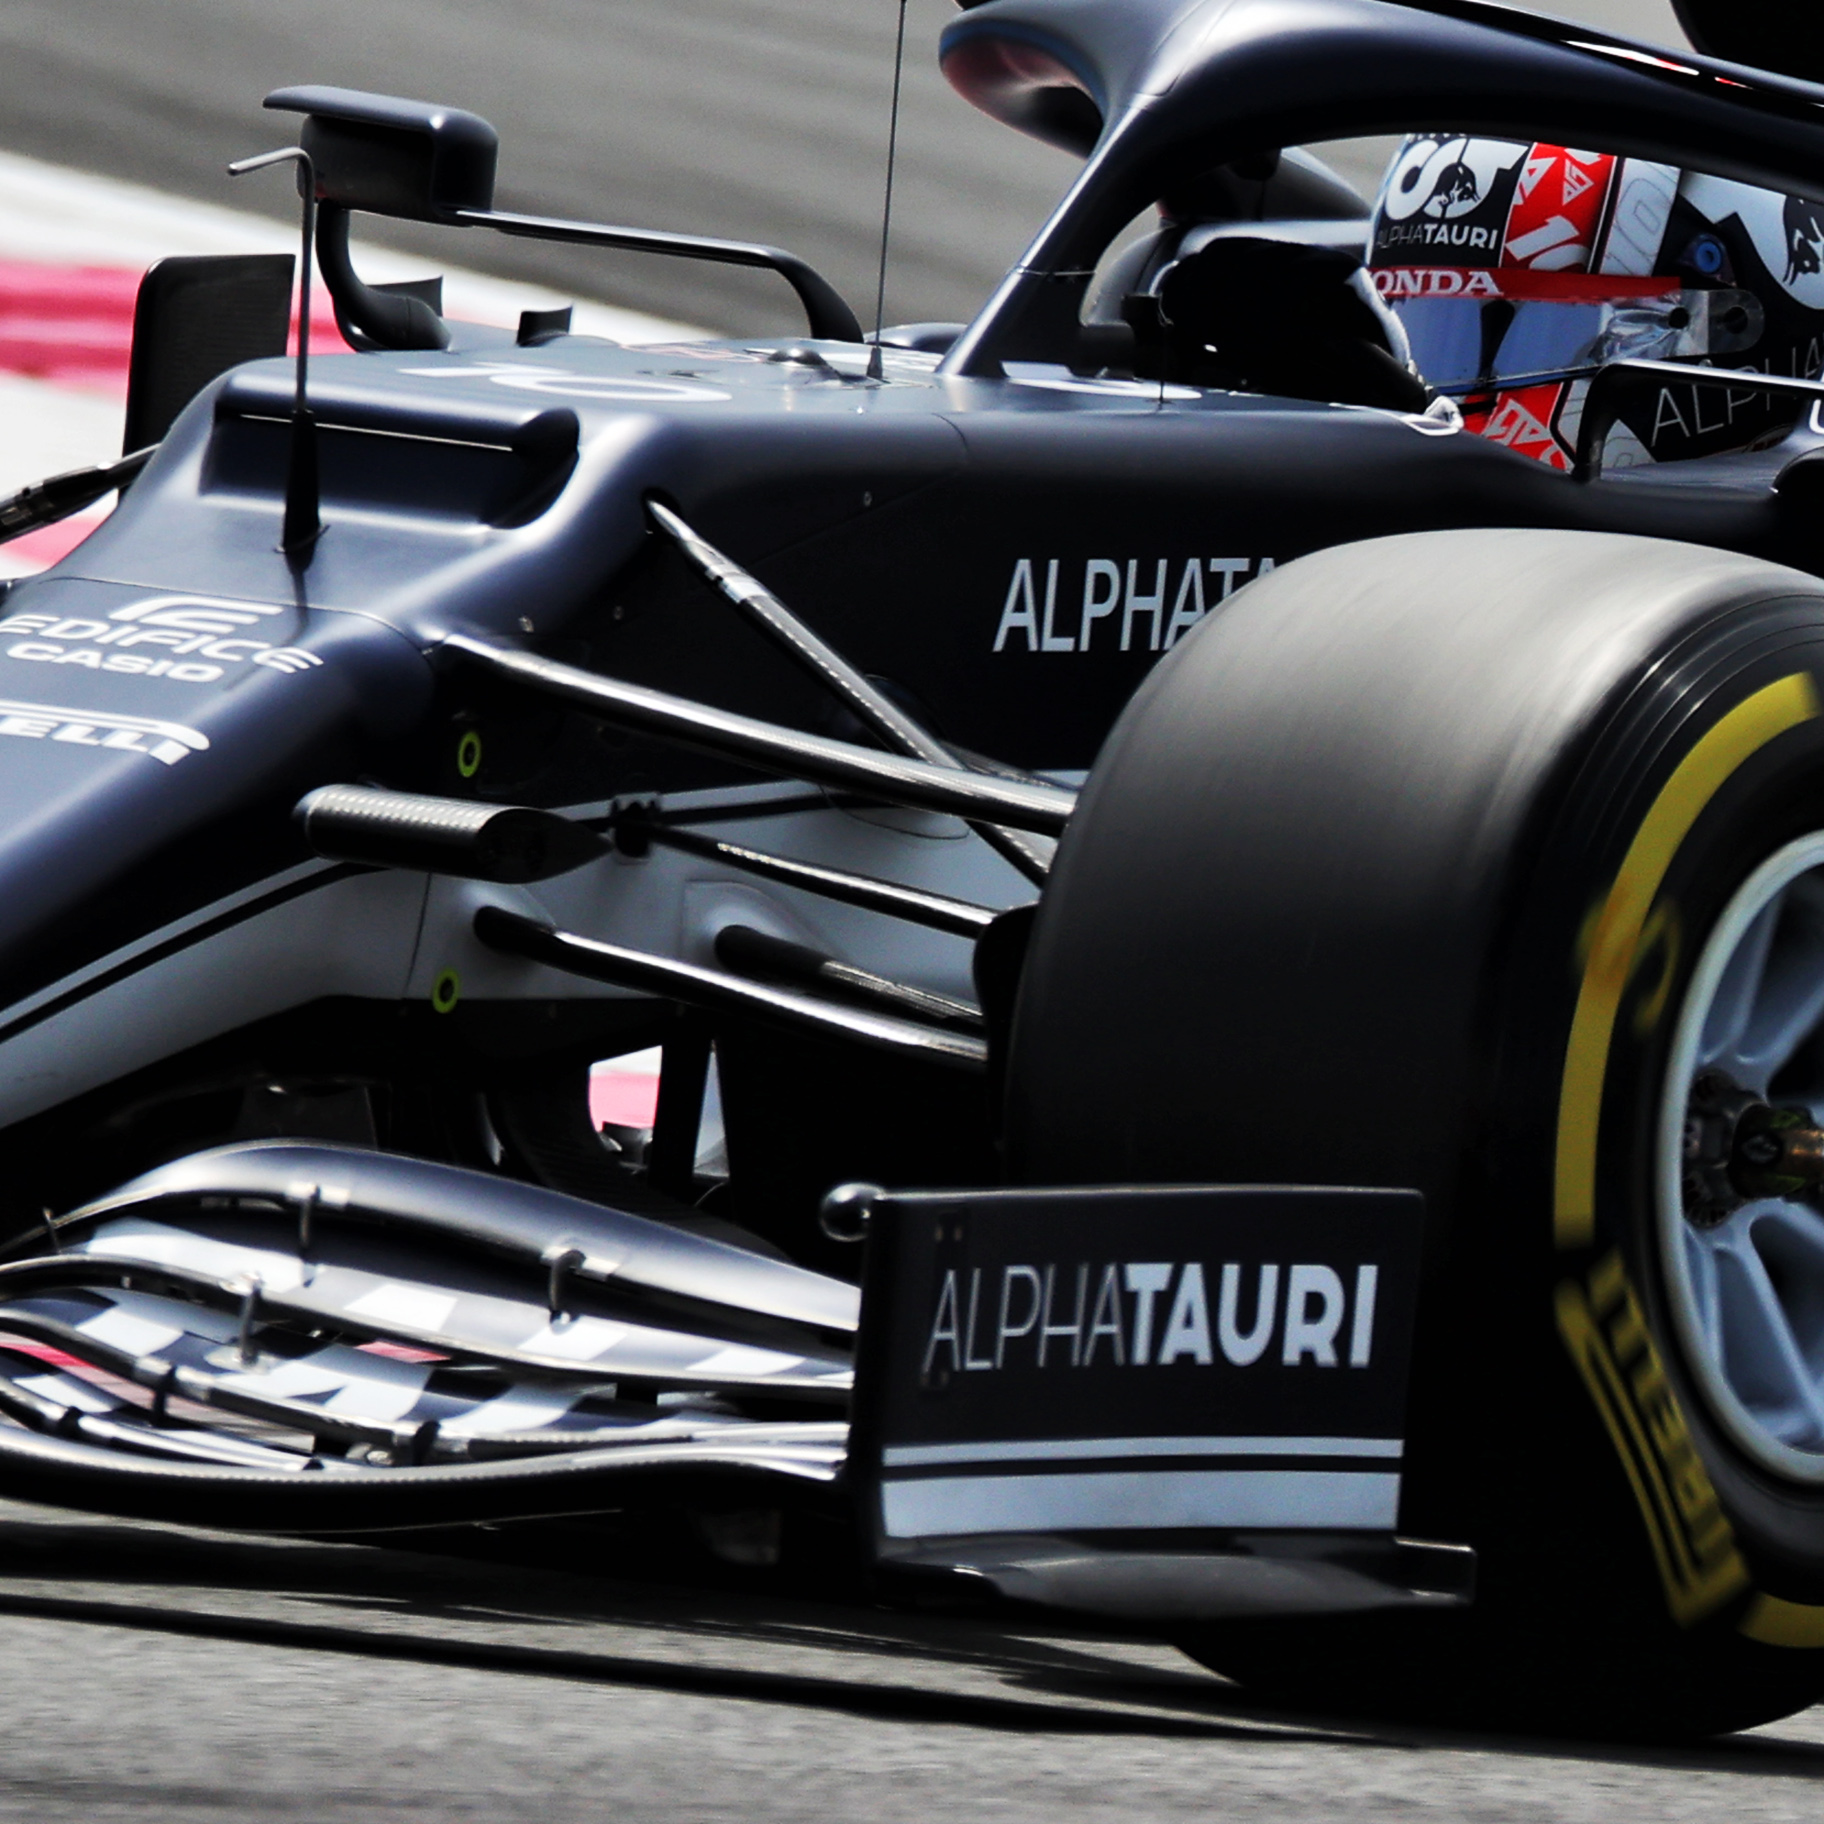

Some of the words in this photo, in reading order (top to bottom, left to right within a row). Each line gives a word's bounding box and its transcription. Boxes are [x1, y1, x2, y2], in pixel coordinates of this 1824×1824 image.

[1368, 269, 1505, 297] ONDA
[6, 642, 225, 683] CASIO
[922, 1262, 1378, 1372] ALPHATAURI
